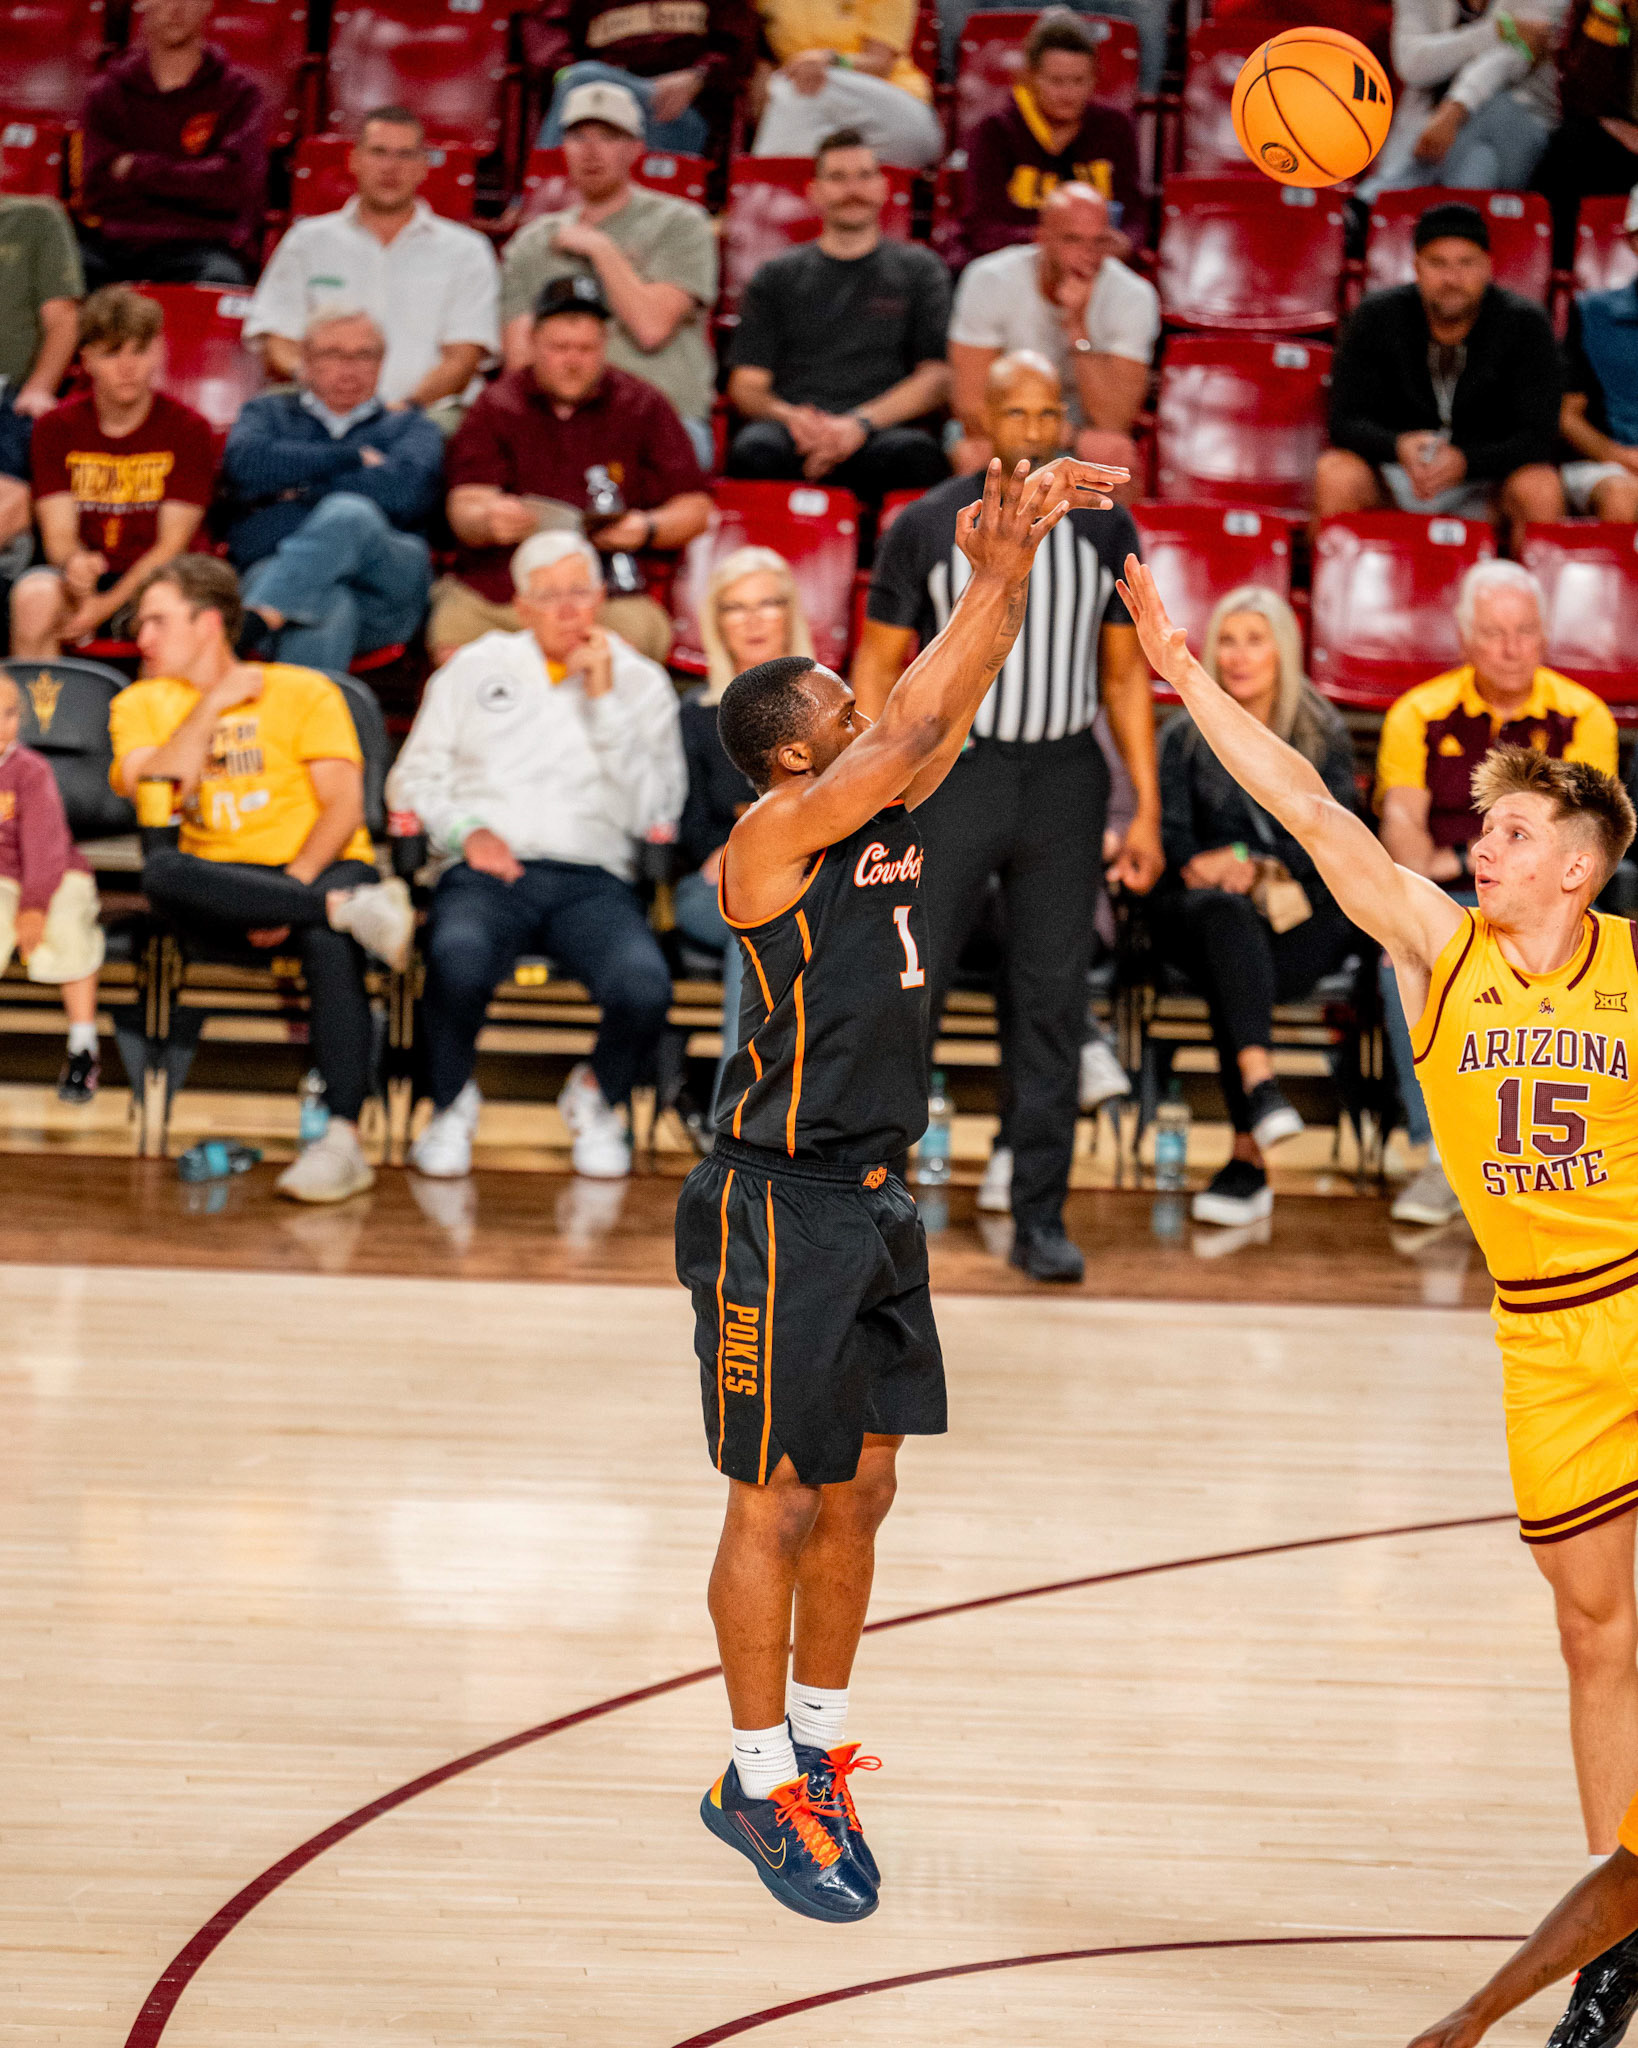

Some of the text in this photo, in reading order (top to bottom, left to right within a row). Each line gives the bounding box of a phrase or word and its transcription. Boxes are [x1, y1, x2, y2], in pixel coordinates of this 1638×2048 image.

[893, 905, 925, 990] 1
[1457, 1026, 1629, 1081] ARIZONA
[1495, 1076, 1591, 1158] 15
[1481, 1148, 1608, 1197] STATE
[724, 1301, 760, 1396] POKES
